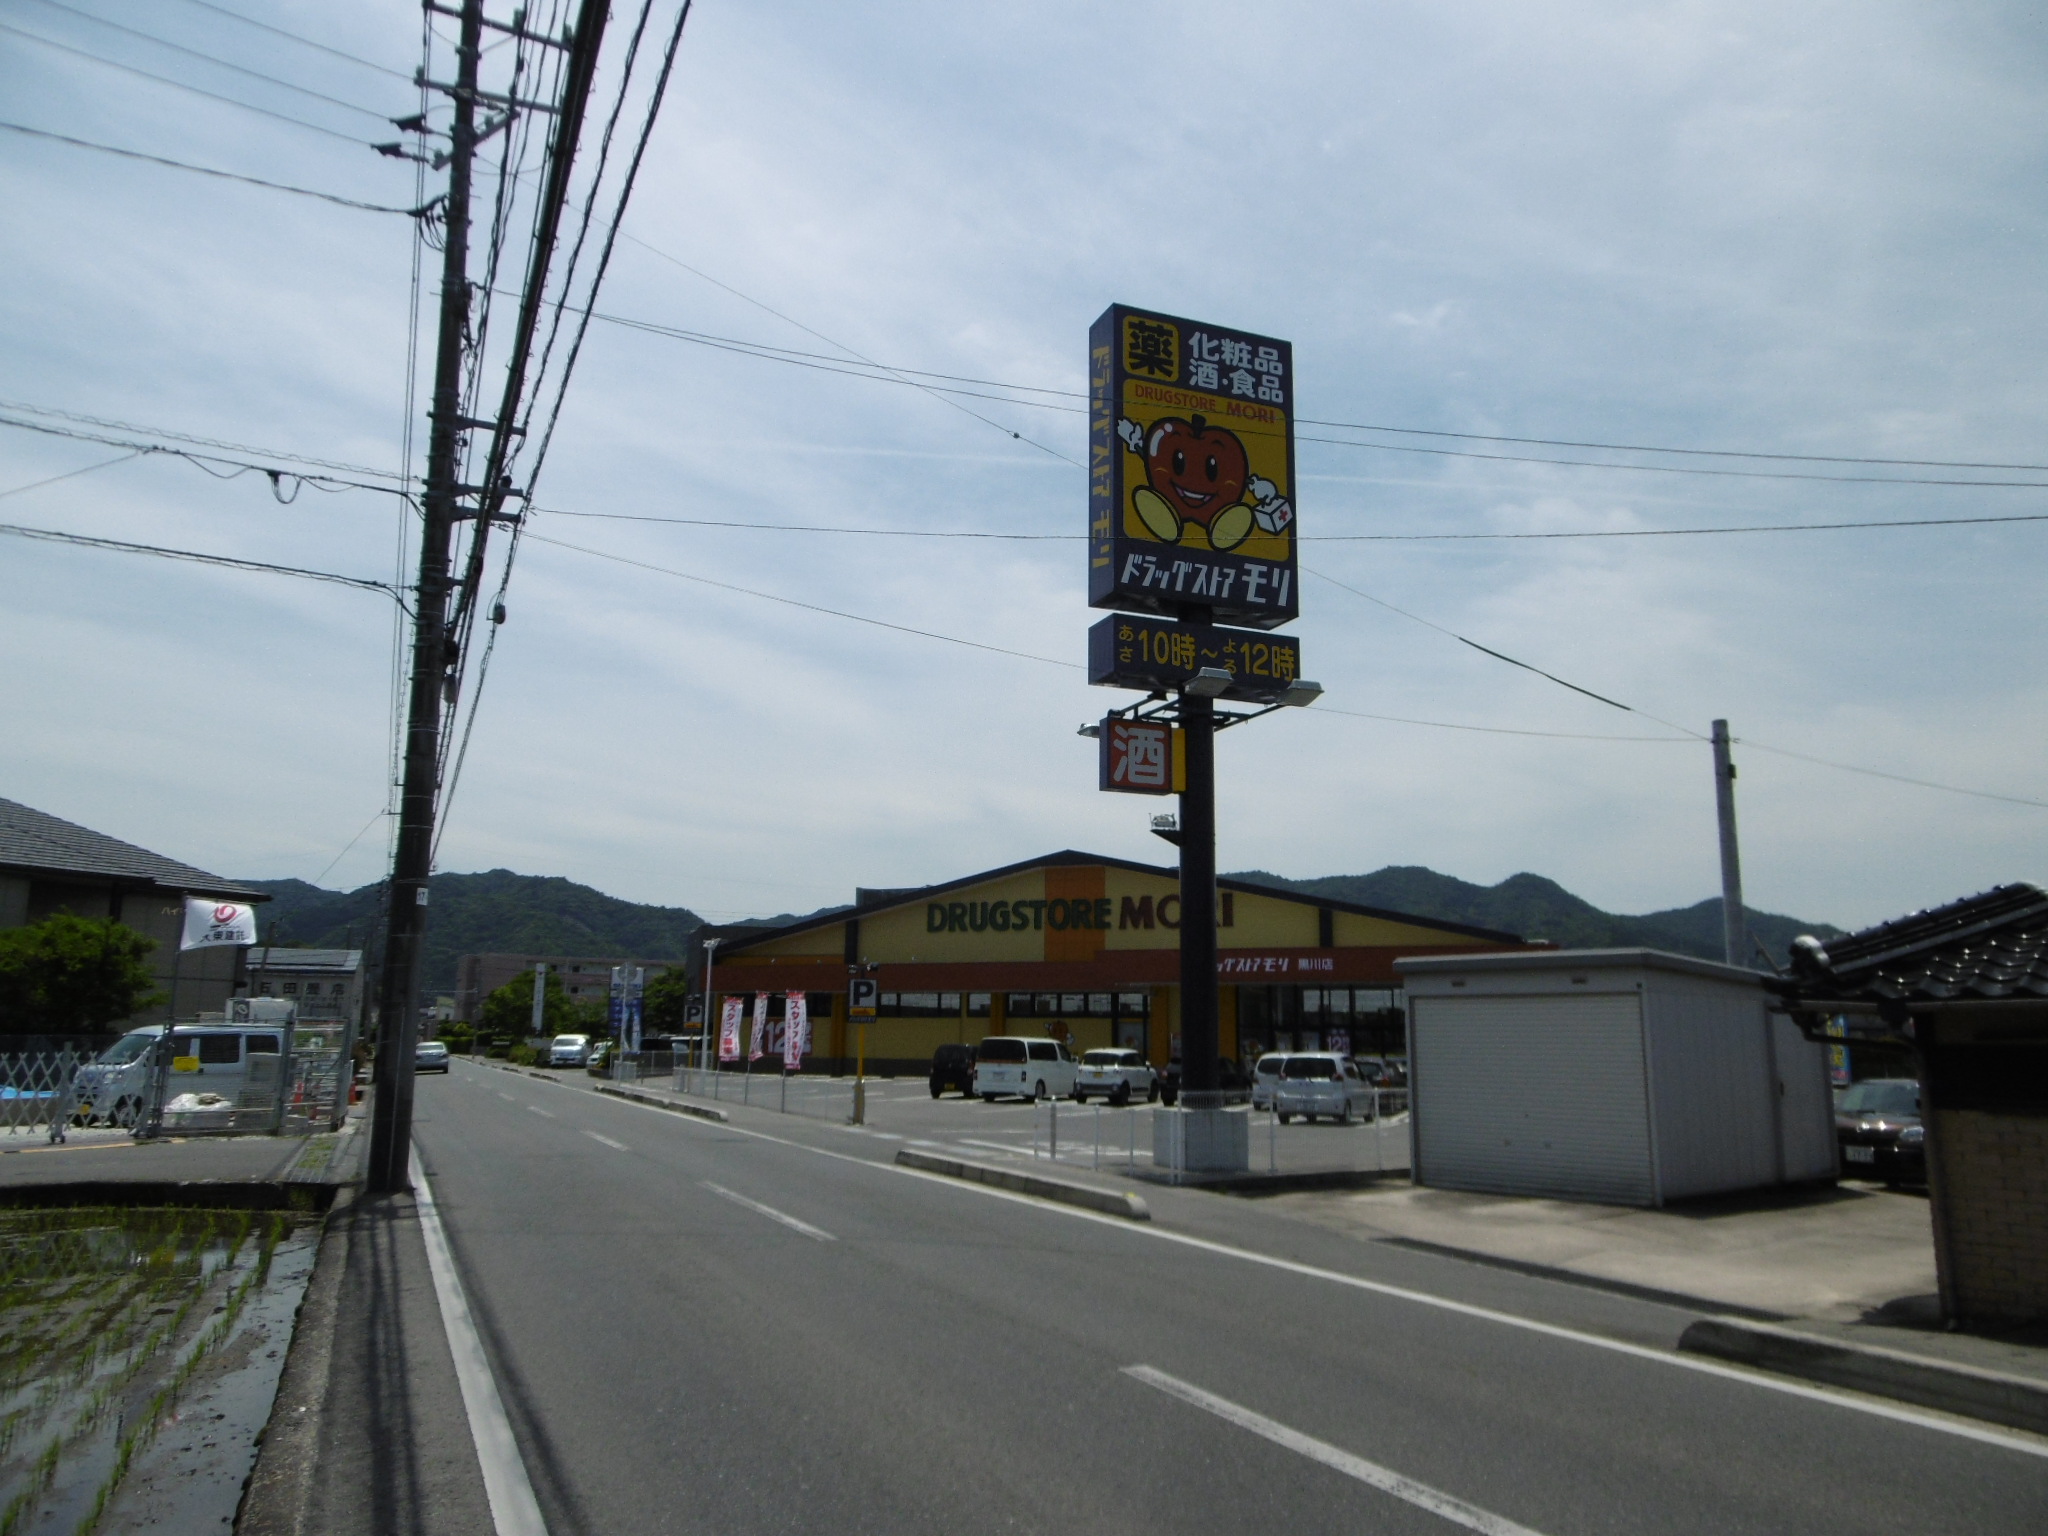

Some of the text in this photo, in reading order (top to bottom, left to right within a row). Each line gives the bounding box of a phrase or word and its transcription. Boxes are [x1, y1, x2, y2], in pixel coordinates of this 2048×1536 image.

[1128, 320, 1174, 378] 薬
[1188, 331, 1284, 376] 化粧品
[1134, 384, 1277, 424] DRUGSTORE MORI
[1118, 624, 1135, 663] あさ
[1240, 643, 1295, 682] 12時
[1113, 724, 1165, 785] 酒
[926, 892, 1235, 933] DRUGSTORE MOI
[686, 1006, 701, 1022] P
[853, 981, 874, 1006] P
